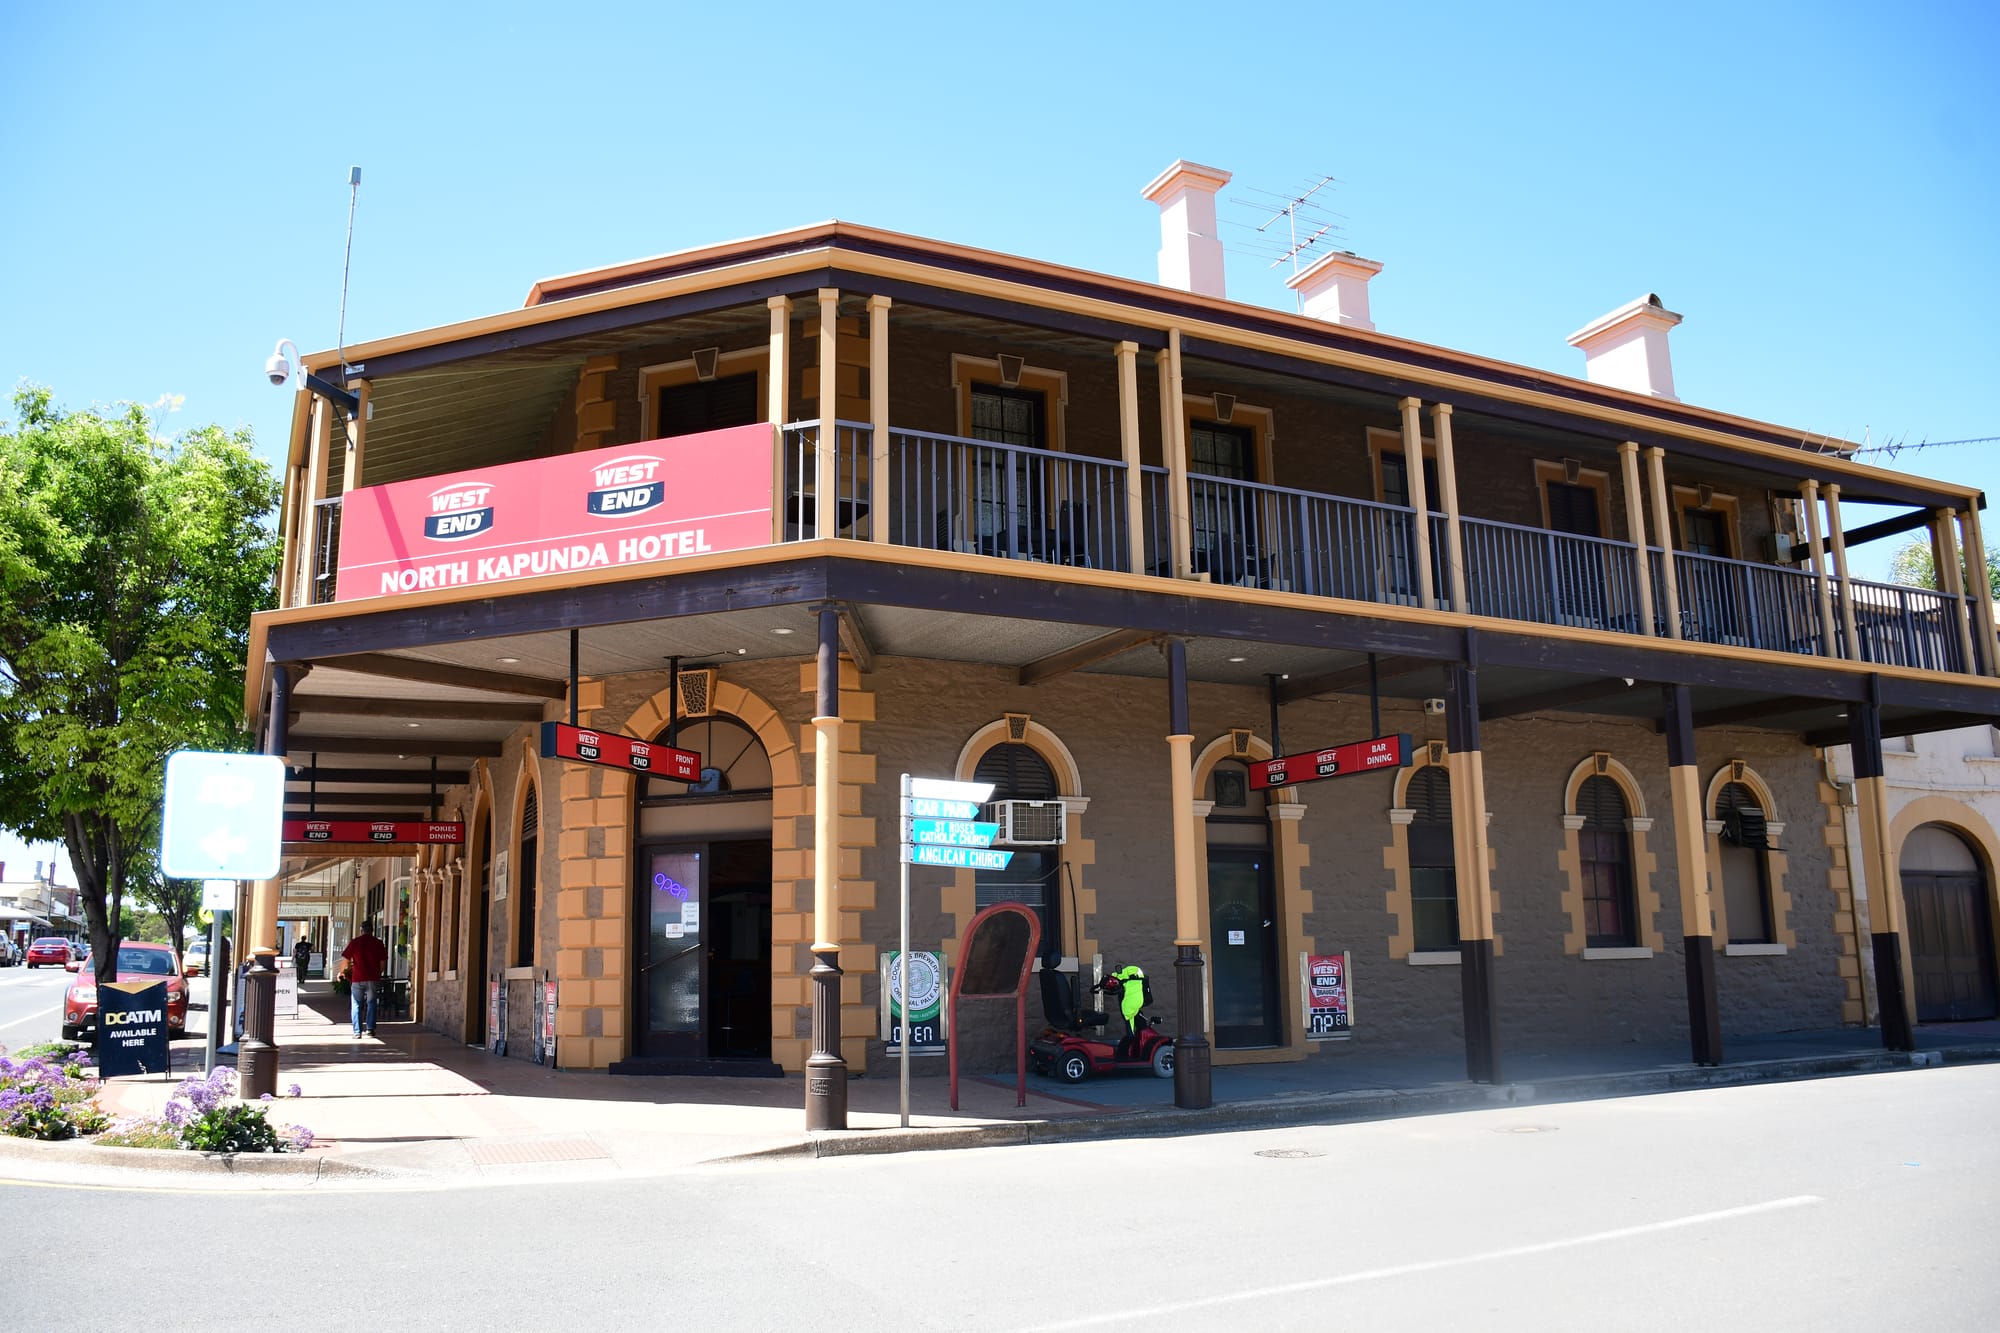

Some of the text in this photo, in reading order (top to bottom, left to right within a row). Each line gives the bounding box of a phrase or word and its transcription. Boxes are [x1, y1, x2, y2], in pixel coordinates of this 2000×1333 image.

[595, 461, 660, 486] WEST
[432, 488, 491, 512] WEST
[601, 489, 652, 512] END
[436, 514, 482, 536] END
[381, 529, 711, 594] NORTH KAPUNDA HOTEL
[578, 733, 599, 745] WEST
[581, 747, 597, 757] END
[631, 745, 650, 756] WEST
[1371, 743, 1387, 753] BAR
[633, 757, 648, 767] END
[675, 754, 694, 766] FRONT
[1316, 752, 1337, 763] WEST
[1367, 753, 1392, 765] DINING
[678, 766, 691, 776] BAR
[1267, 762, 1286, 772] WEST
[1319, 764, 1336, 773] END
[1270, 773, 1285, 782] END
[917, 801, 971, 817] CAR PARK
[935, 822, 975, 833] ST ROSES
[920, 832, 989, 845] CATHOLIC CHURCH
[919, 847, 1005, 869] ANGLICAN CHURCH
[1313, 966, 1339, 975] WEST
[1316, 977, 1337, 986] END
[1316, 989, 1339, 997] DRAUGHT
[110, 1028, 157, 1039] AVAILABLE
[122, 1039, 144, 1047] HERE
